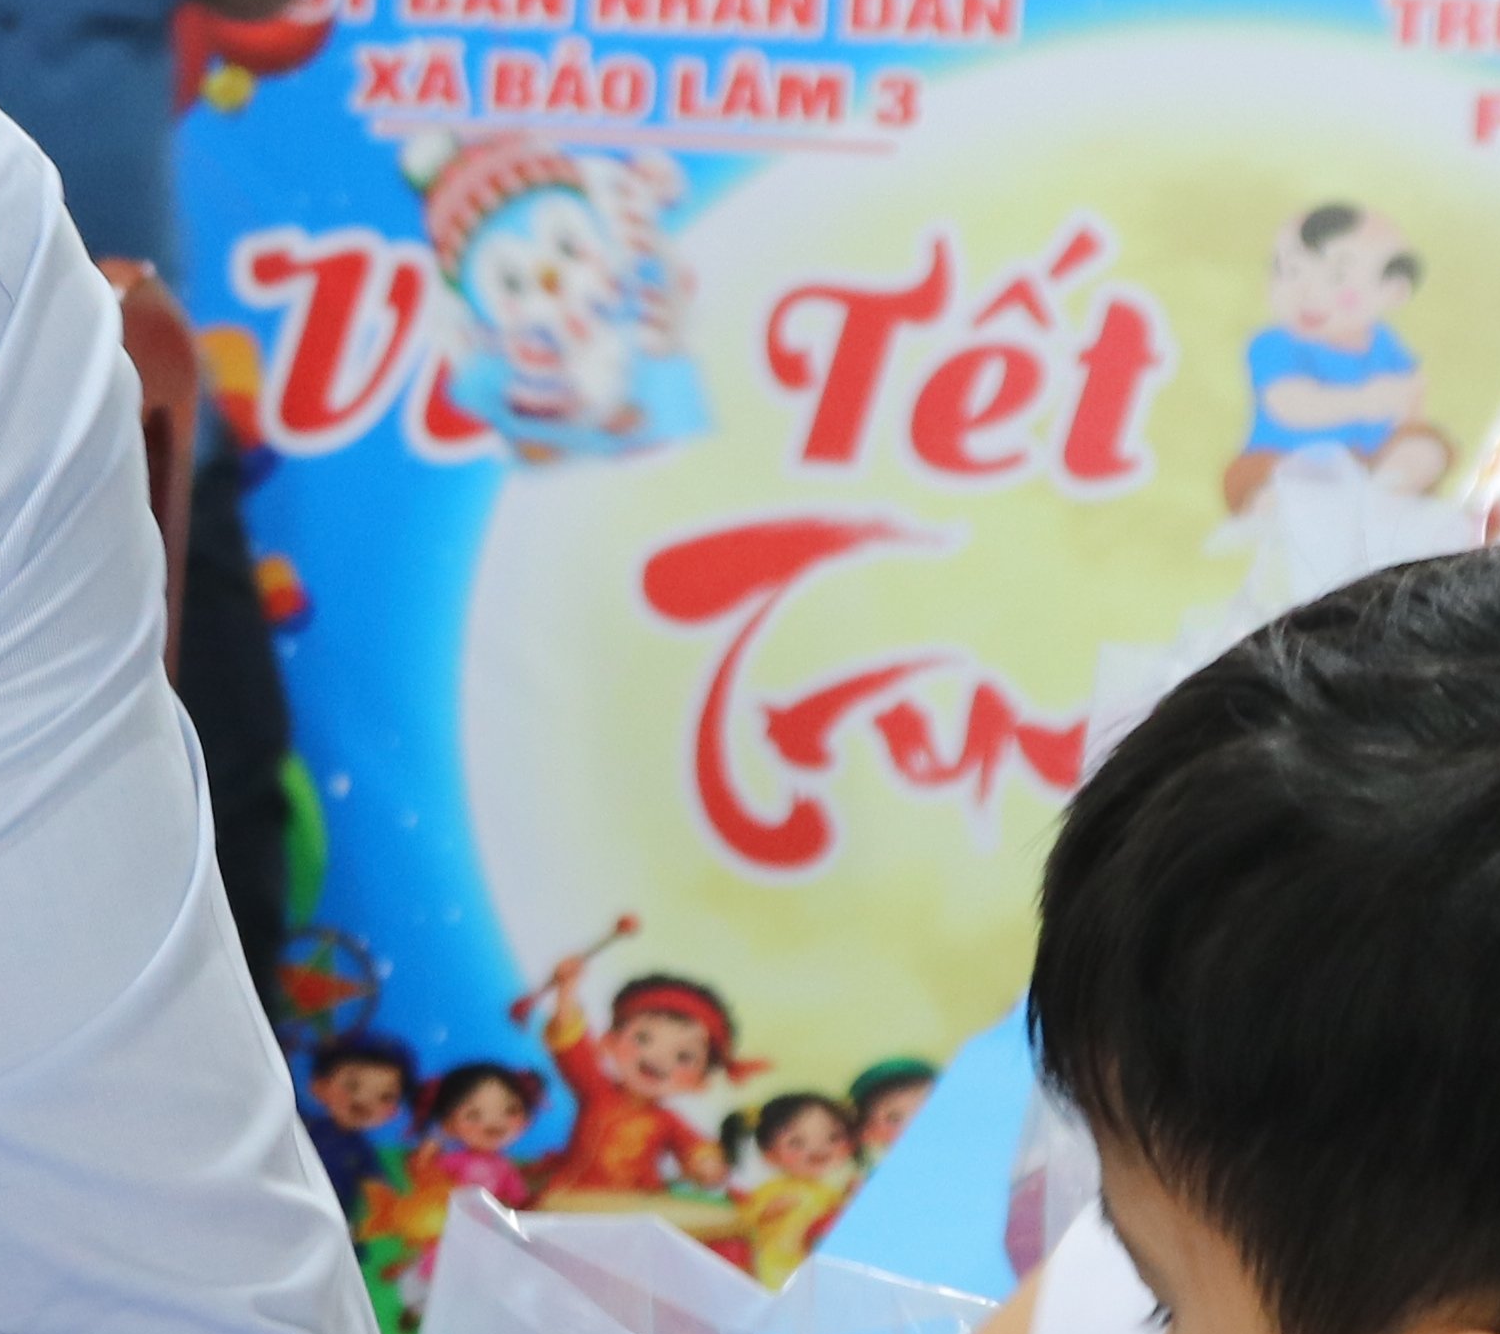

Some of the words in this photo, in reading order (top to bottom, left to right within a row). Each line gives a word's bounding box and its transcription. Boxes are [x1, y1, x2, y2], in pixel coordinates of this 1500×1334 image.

[674, 51, 846, 121] LÂM
[872, 75, 922, 125] 3
[766, 227, 1163, 481] Tết
